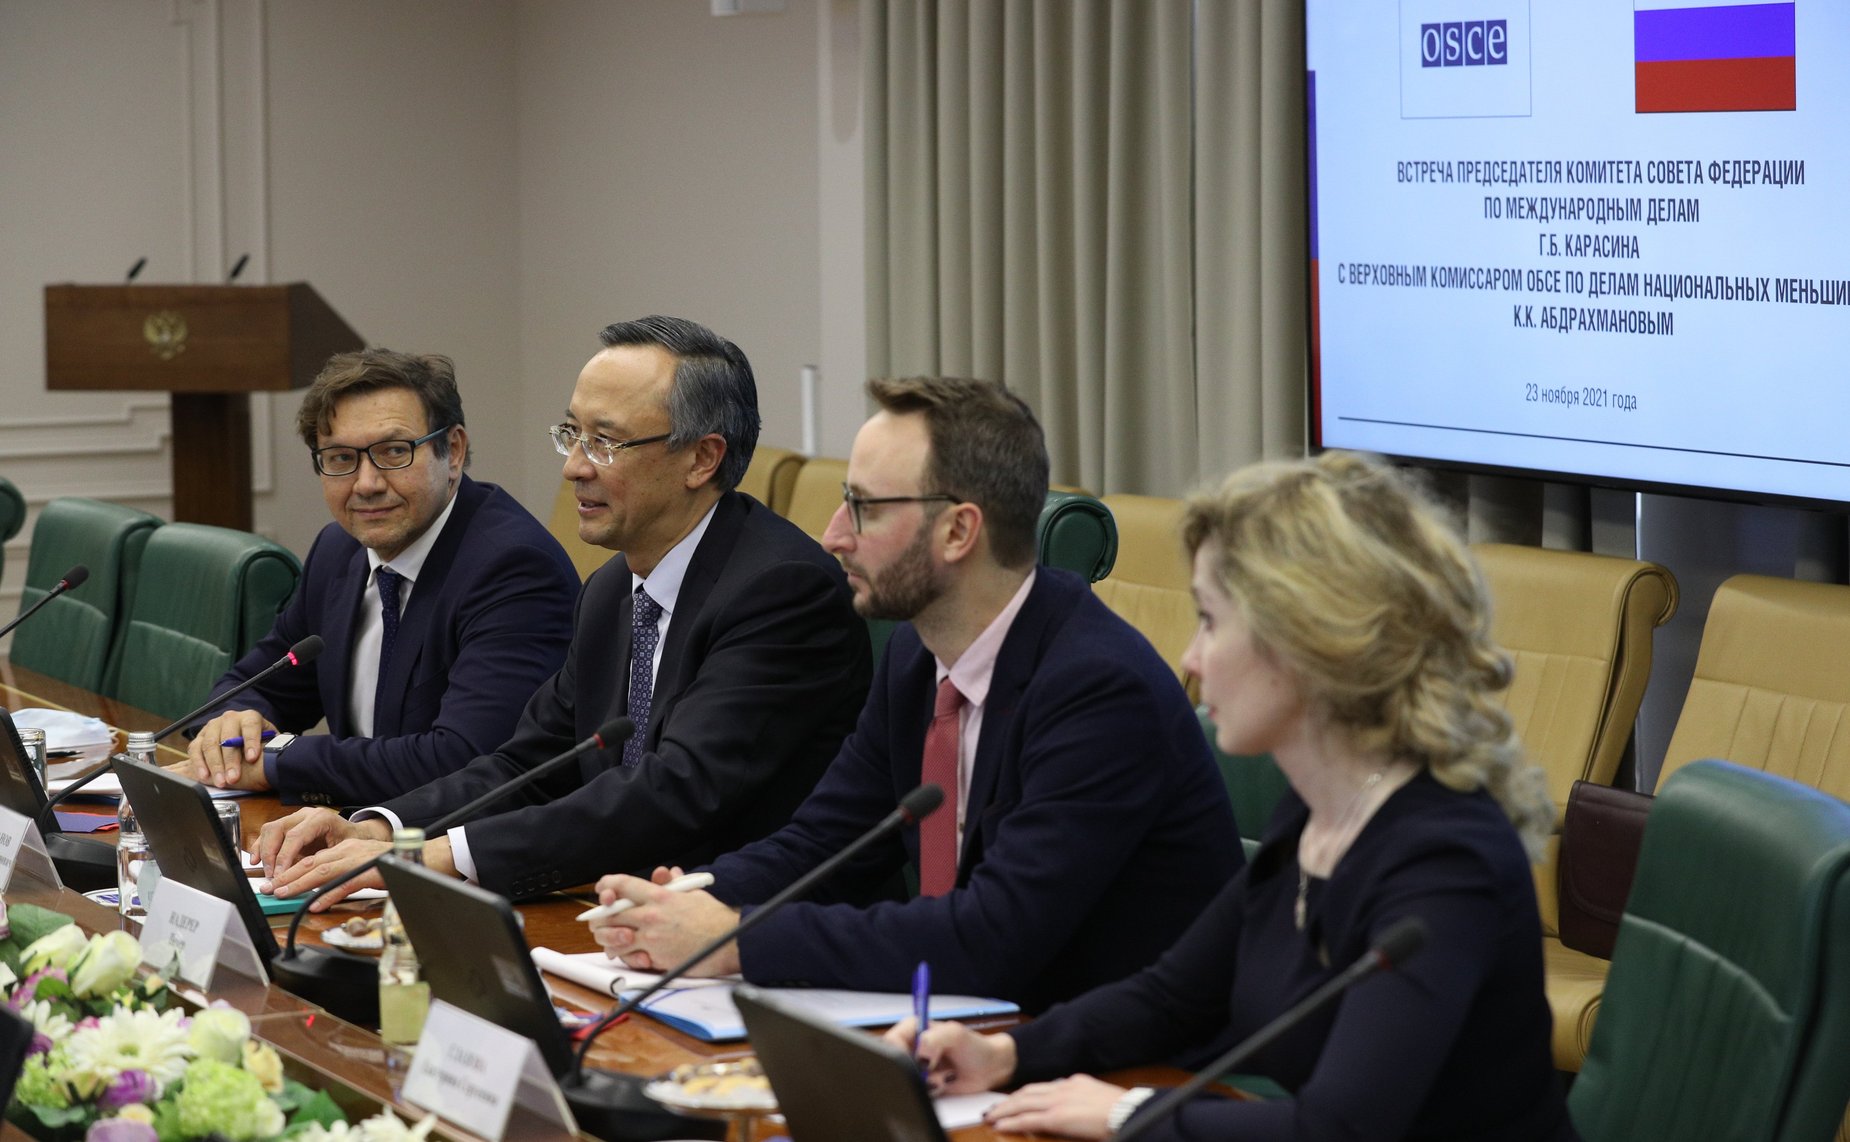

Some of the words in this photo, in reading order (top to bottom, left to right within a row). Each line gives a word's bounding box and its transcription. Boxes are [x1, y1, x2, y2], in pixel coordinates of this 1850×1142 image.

[1422, 25, 1506, 62] osce
[1397, 161, 1453, 183] ВСТРЕЧА
[1457, 161, 1562, 187] ПРЕДСЕДАТЕЛЯ
[1567, 160, 1643, 184] КОМИТЕТА
[1647, 160, 1704, 184] СОВЕТА
[1708, 160, 1805, 189] ФЕДЕРАЦИИ
[1484, 197, 1501, 219] ПО
[1506, 197, 1642, 224] МЕЖДУНАРОДНЫМ
[1647, 198, 1700, 226] ДЕЛАМ
[1539, 234, 1561, 256] Г.Б.
[1565, 234, 1640, 259] КАРАСИНА
[1337, 263, 1346, 284] С
[1349, 263, 1427, 287] ВЕРХОВНЫМ
[1431, 266, 1523, 291] КОМИССАРОМ
[1527, 270, 1561, 293] ОБСЕ
[1565, 270, 1584, 294] ПО
[1588, 271, 1639, 298] ДЕЛАМ
[1643, 273, 1770, 302] НАЦИОНАЛЬНЫХ
[1775, 278, 1850, 306] МЕНЬШИ
[1514, 305, 1537, 328] К.К.
[1541, 306, 1674, 336] АБДРАХМАНОВЫМ
[1525, 383, 1539, 401] 23
[1541, 386, 1580, 408] ноября
[1583, 387, 1607, 407] 2021
[1612, 393, 1637, 412] года
